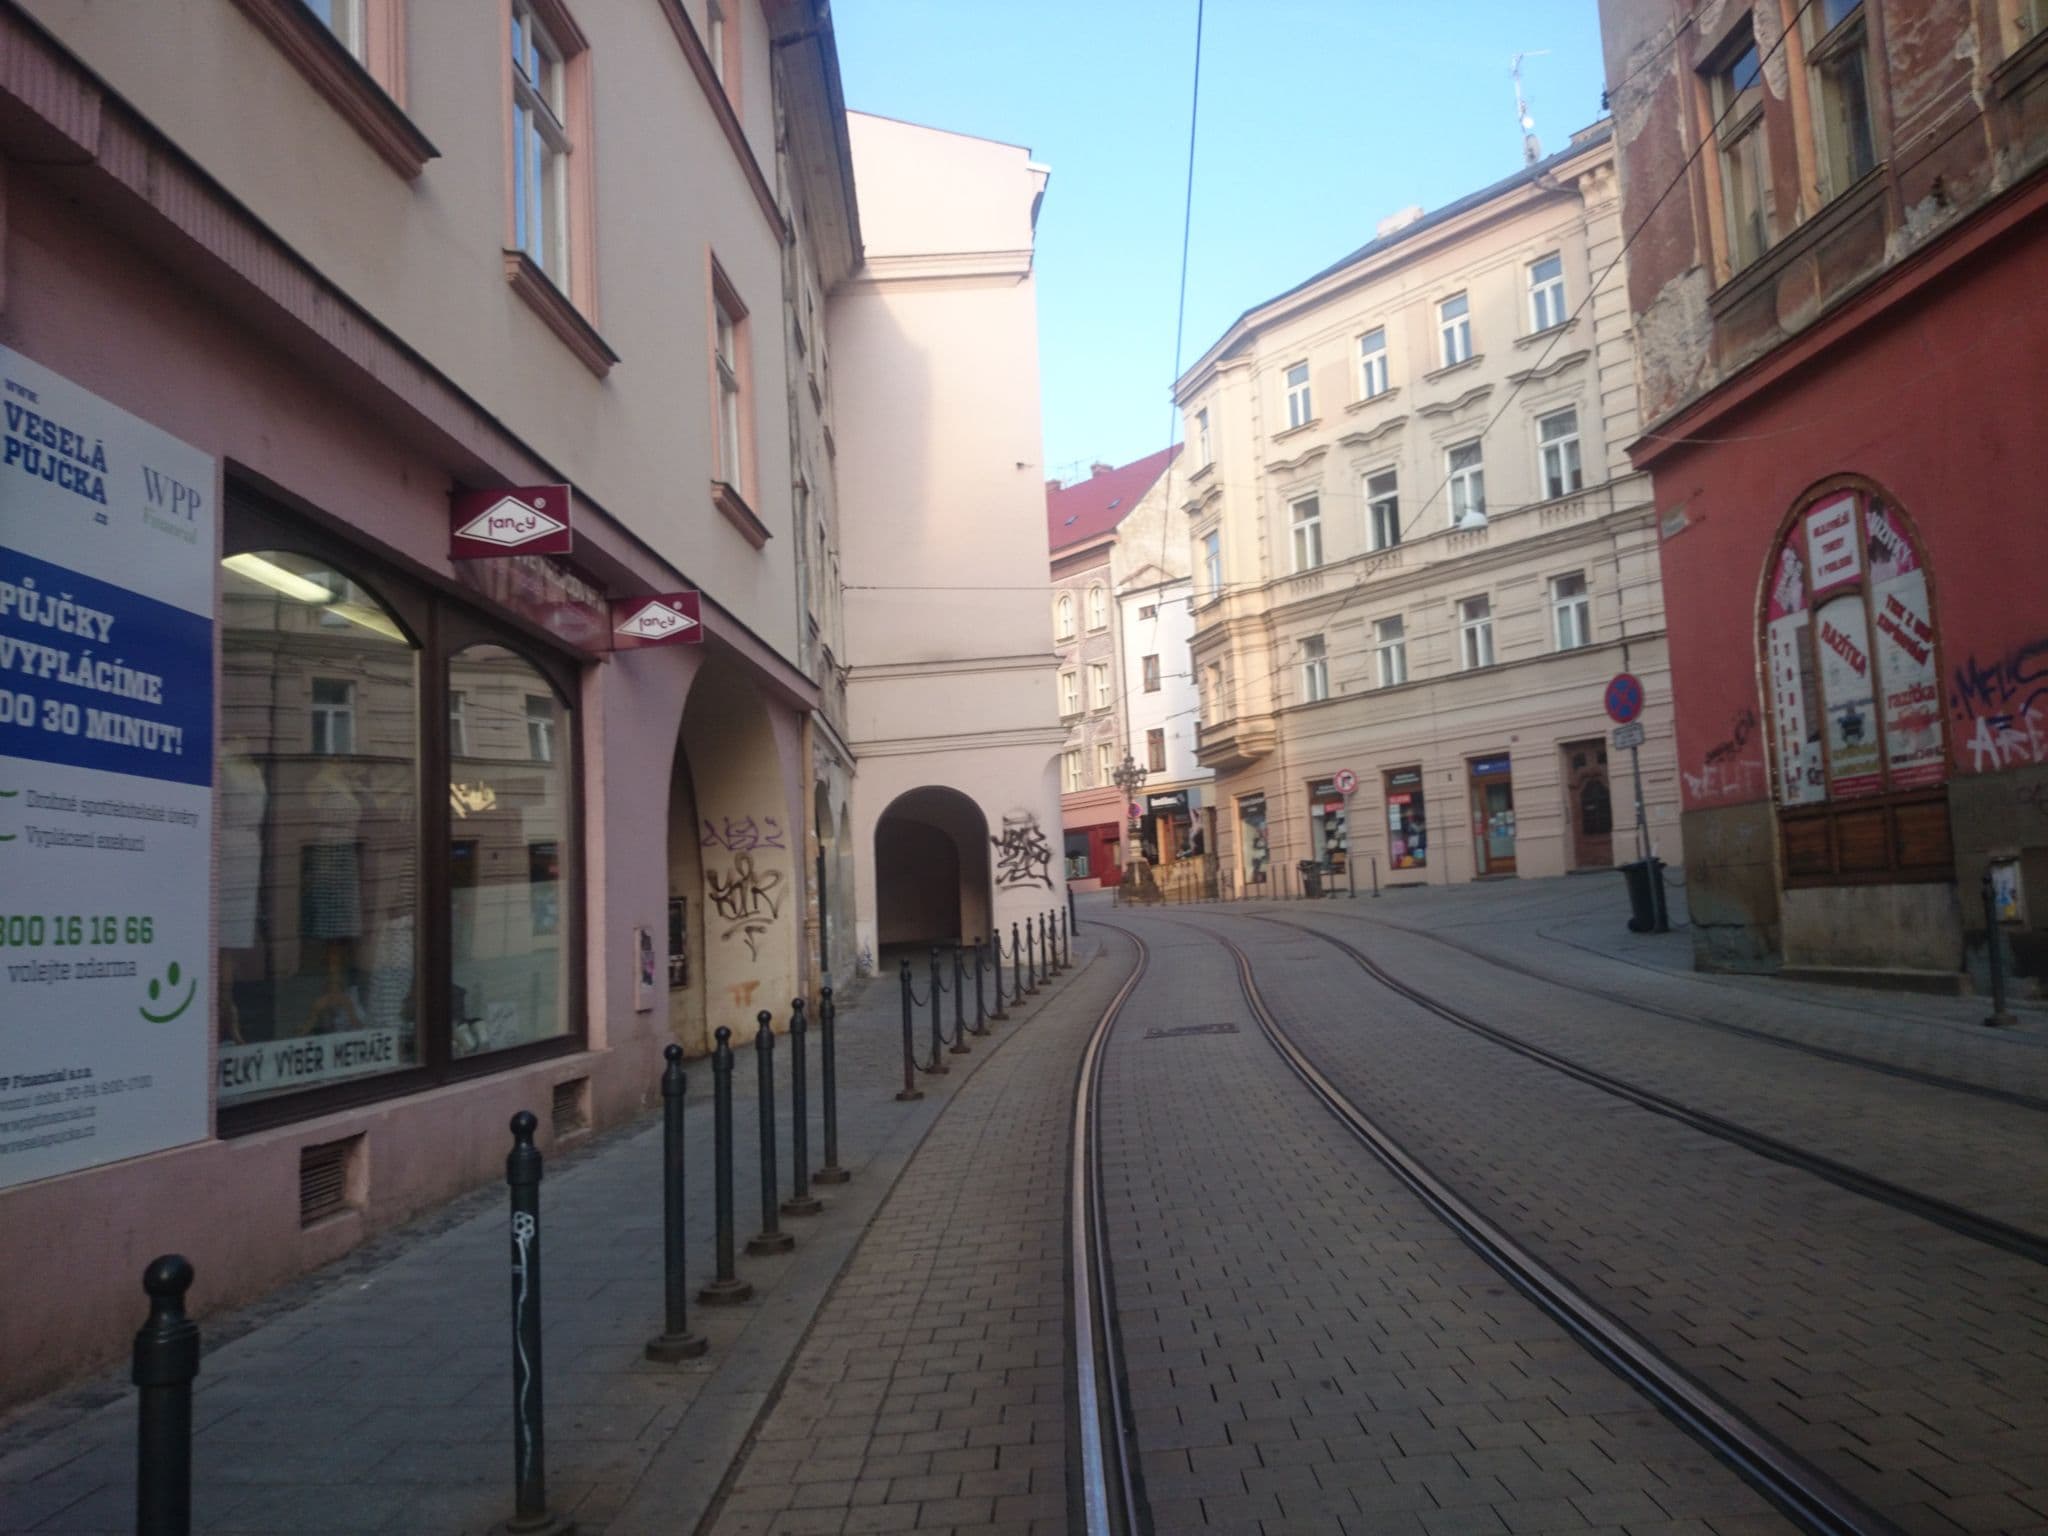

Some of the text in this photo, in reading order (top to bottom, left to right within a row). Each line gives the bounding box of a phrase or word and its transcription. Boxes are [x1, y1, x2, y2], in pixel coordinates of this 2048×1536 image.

[4, 399, 108, 473] VESELÁ
[143, 464, 202, 521] WPP
[487, 514, 537, 537] fancy
[0, 576, 114, 643] PŮJČKY
[639, 616, 676, 632] fancy
[0, 634, 163, 704] VYPLÁCÍME
[1821, 621, 1867, 677] RAZÍTKA
[42, 699, 80, 736] 30
[86, 708, 183, 755] MINUT!
[0, 915, 154, 946] 00 16 16 66
